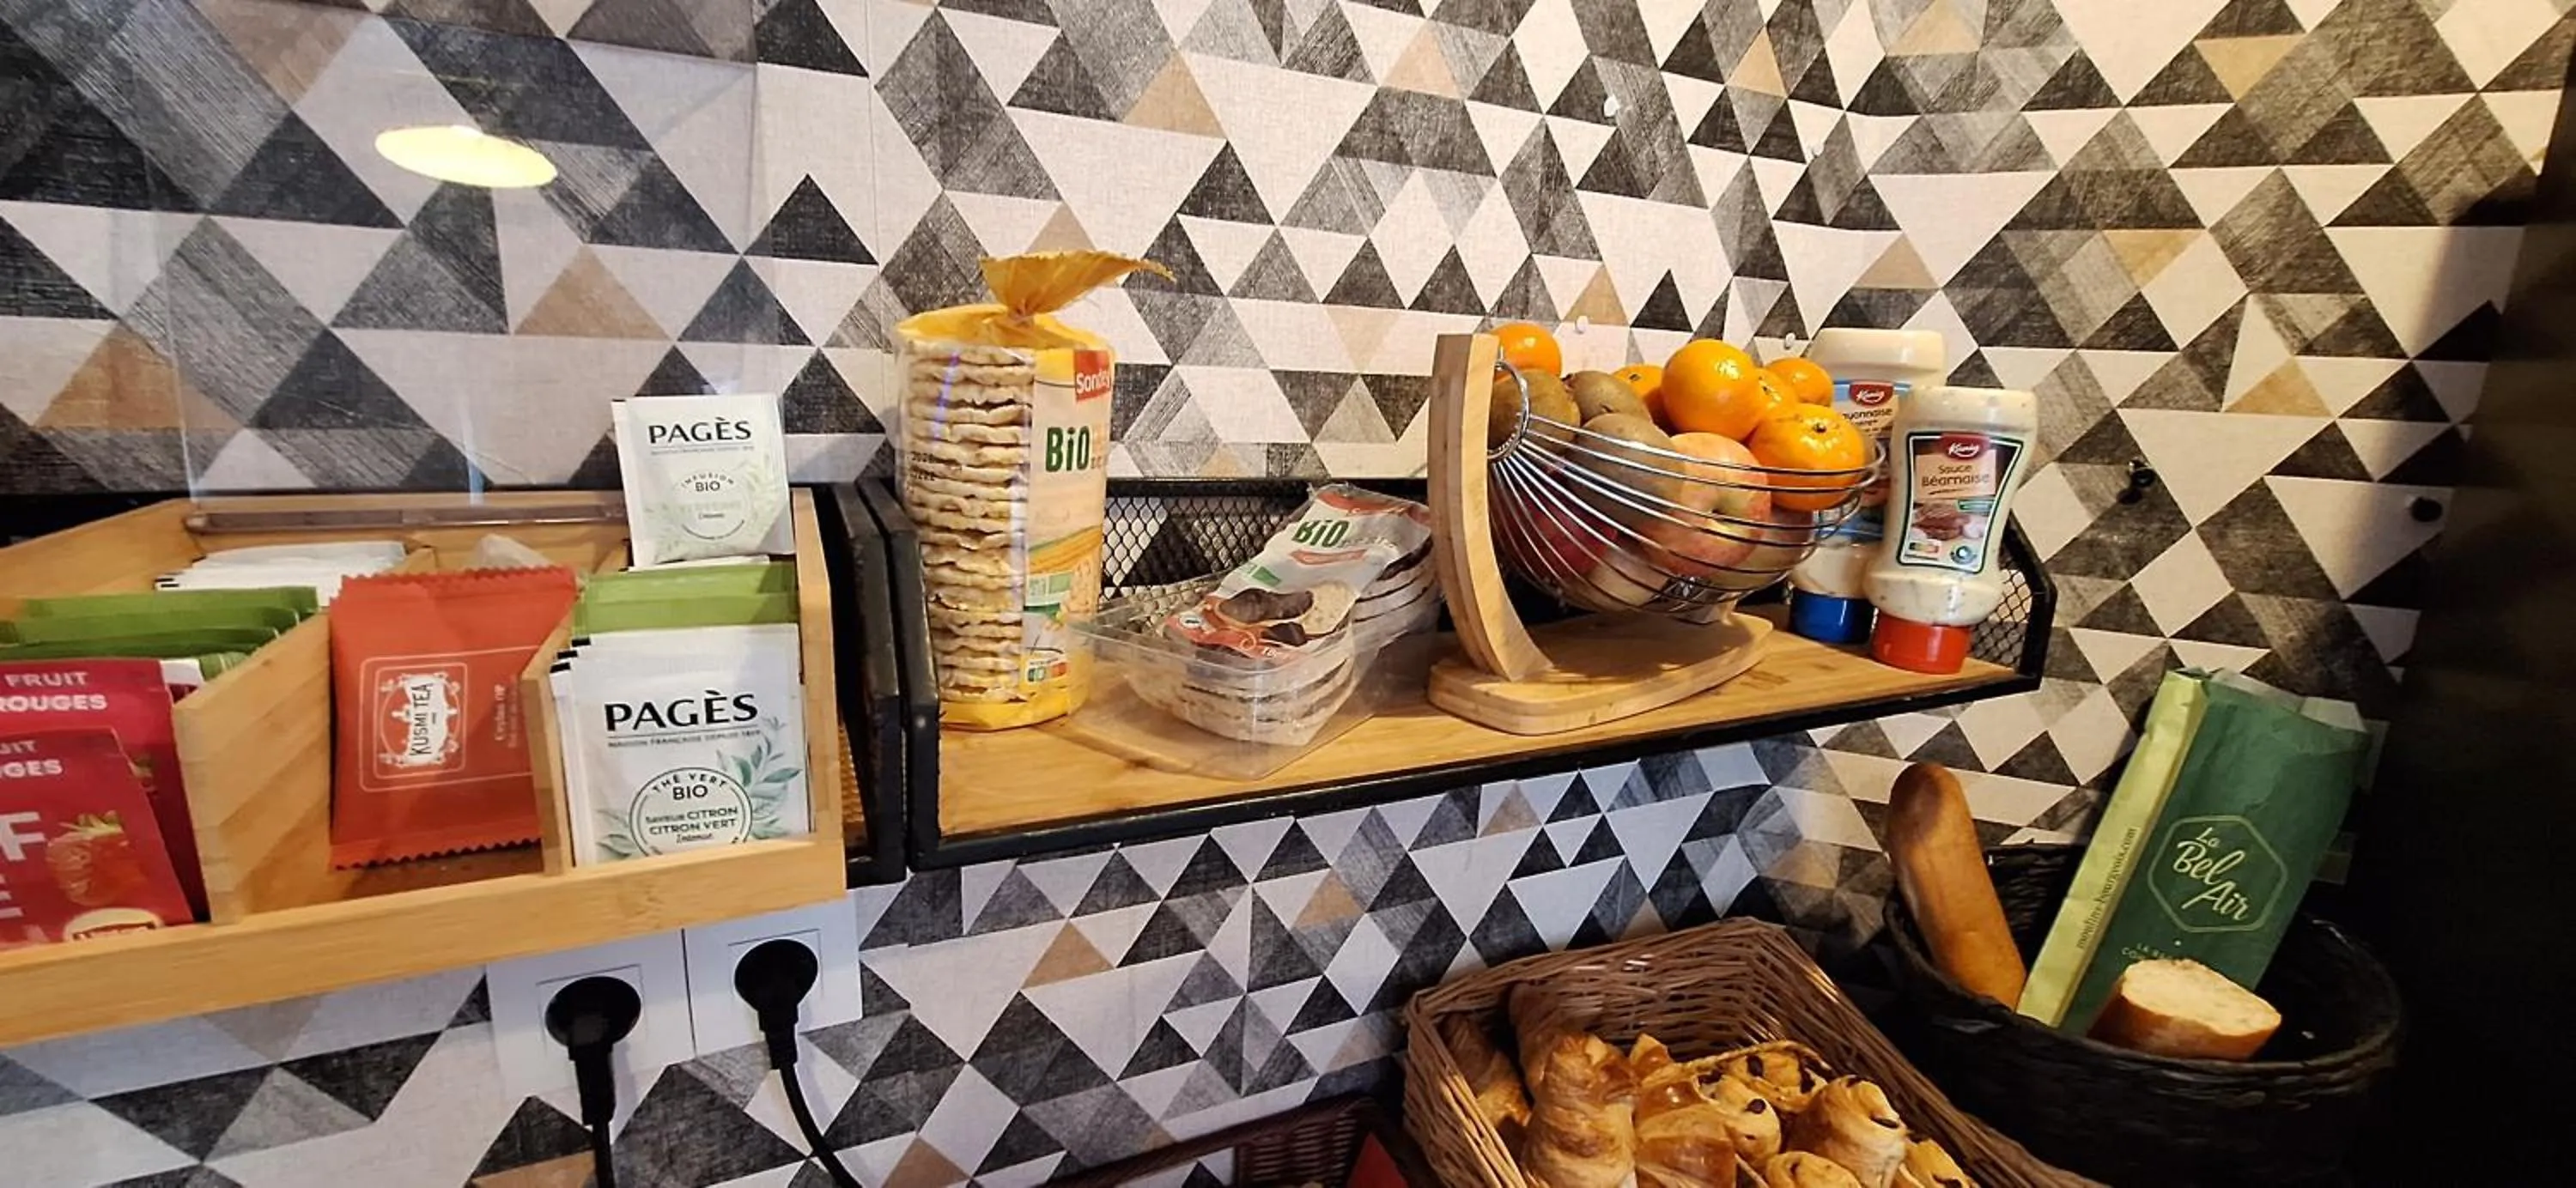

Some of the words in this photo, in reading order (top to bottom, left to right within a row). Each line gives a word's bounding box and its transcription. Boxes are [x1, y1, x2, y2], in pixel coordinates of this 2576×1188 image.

[648, 416, 752, 444] PAGÈS
[1937, 464, 1973, 475] Sauce
[695, 481, 720, 492] BIO
[1921, 472, 1990, 487] Béarnaise
[4, 671, 88, 688] FRUIT
[411, 684, 434, 709] TEA
[605, 689, 759, 731] PAGÈS
[410, 713, 432, 755] KUSMI
[0, 760, 63, 779] GES
[689, 773, 727, 788] VERT
[672, 784, 708, 801] BIO
[686, 806, 738, 821] CITRON
[649, 823, 701, 835] CITRON
[703, 818, 736, 830] VERT
[2196, 827, 2221, 848] La
[2172, 840, 2246, 886] Bel
[2181, 881, 2249, 921] Air
